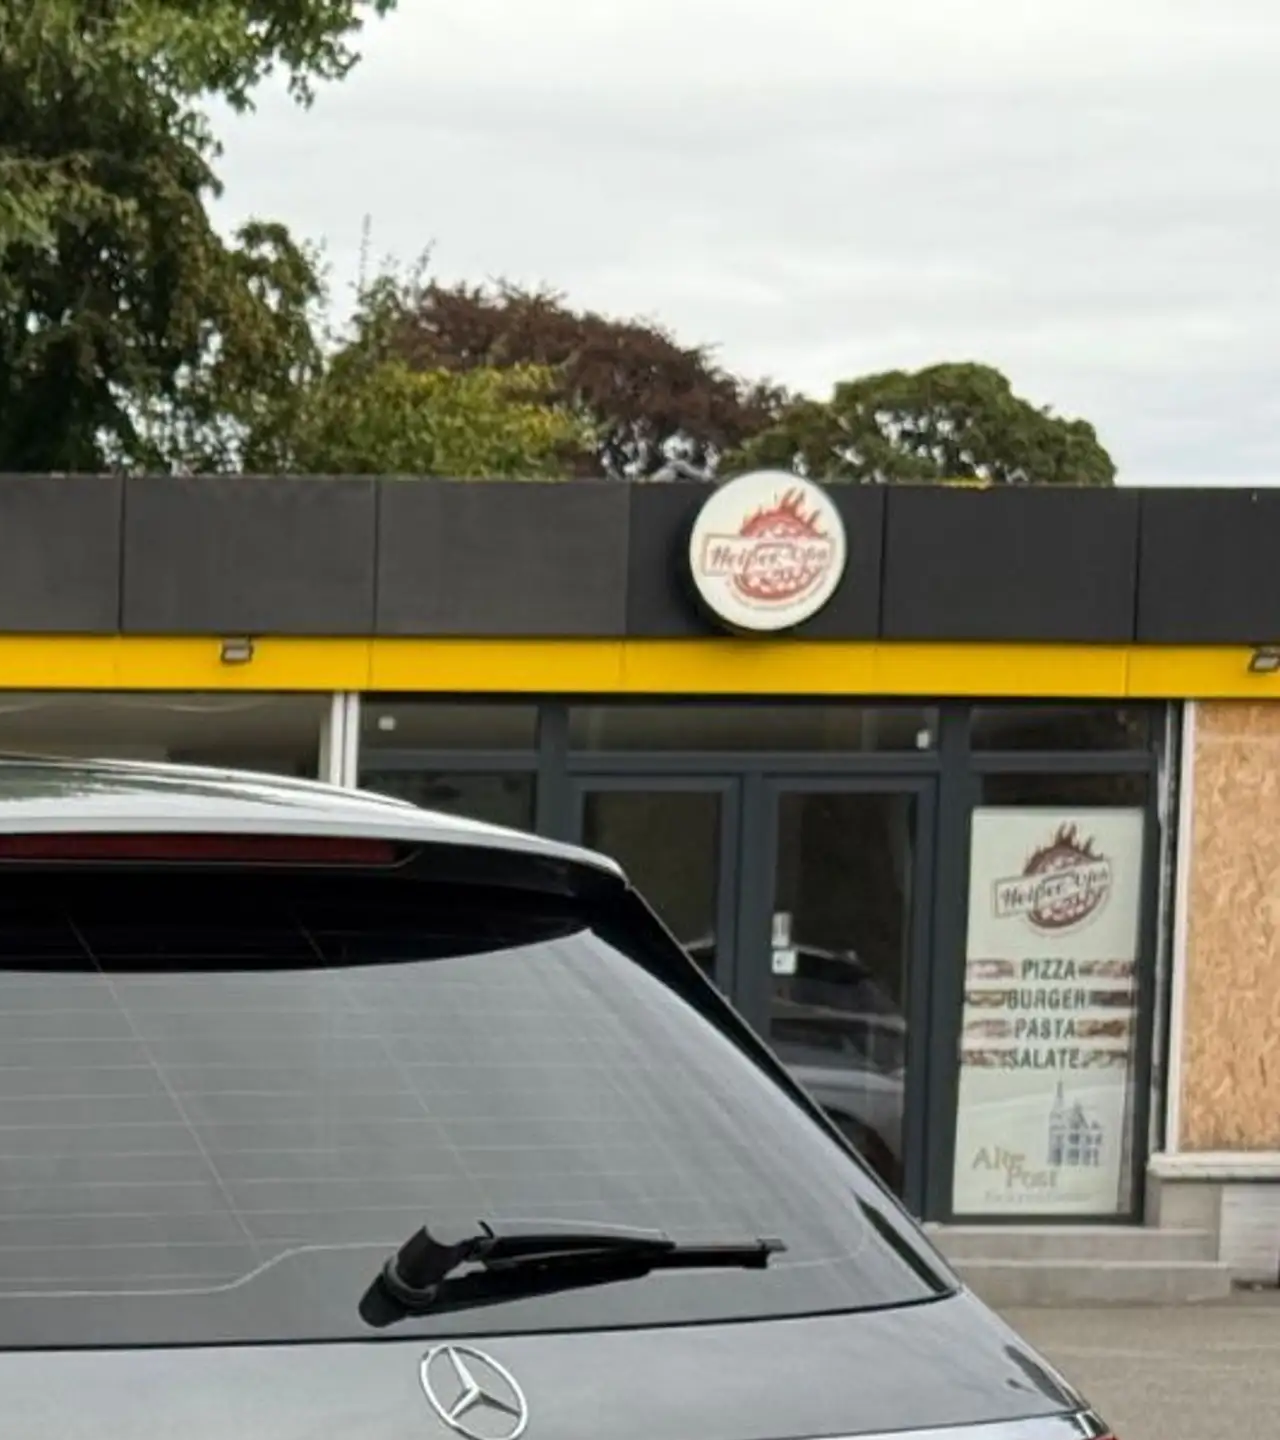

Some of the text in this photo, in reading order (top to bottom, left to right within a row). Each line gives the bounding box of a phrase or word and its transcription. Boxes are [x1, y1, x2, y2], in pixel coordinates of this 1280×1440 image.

[1020, 958, 1078, 979] PIZZA
[1006, 988, 1087, 1010] BURGER
[1014, 1018, 1077, 1039] PASTA
[1008, 1048, 1079, 1069] SALATE
